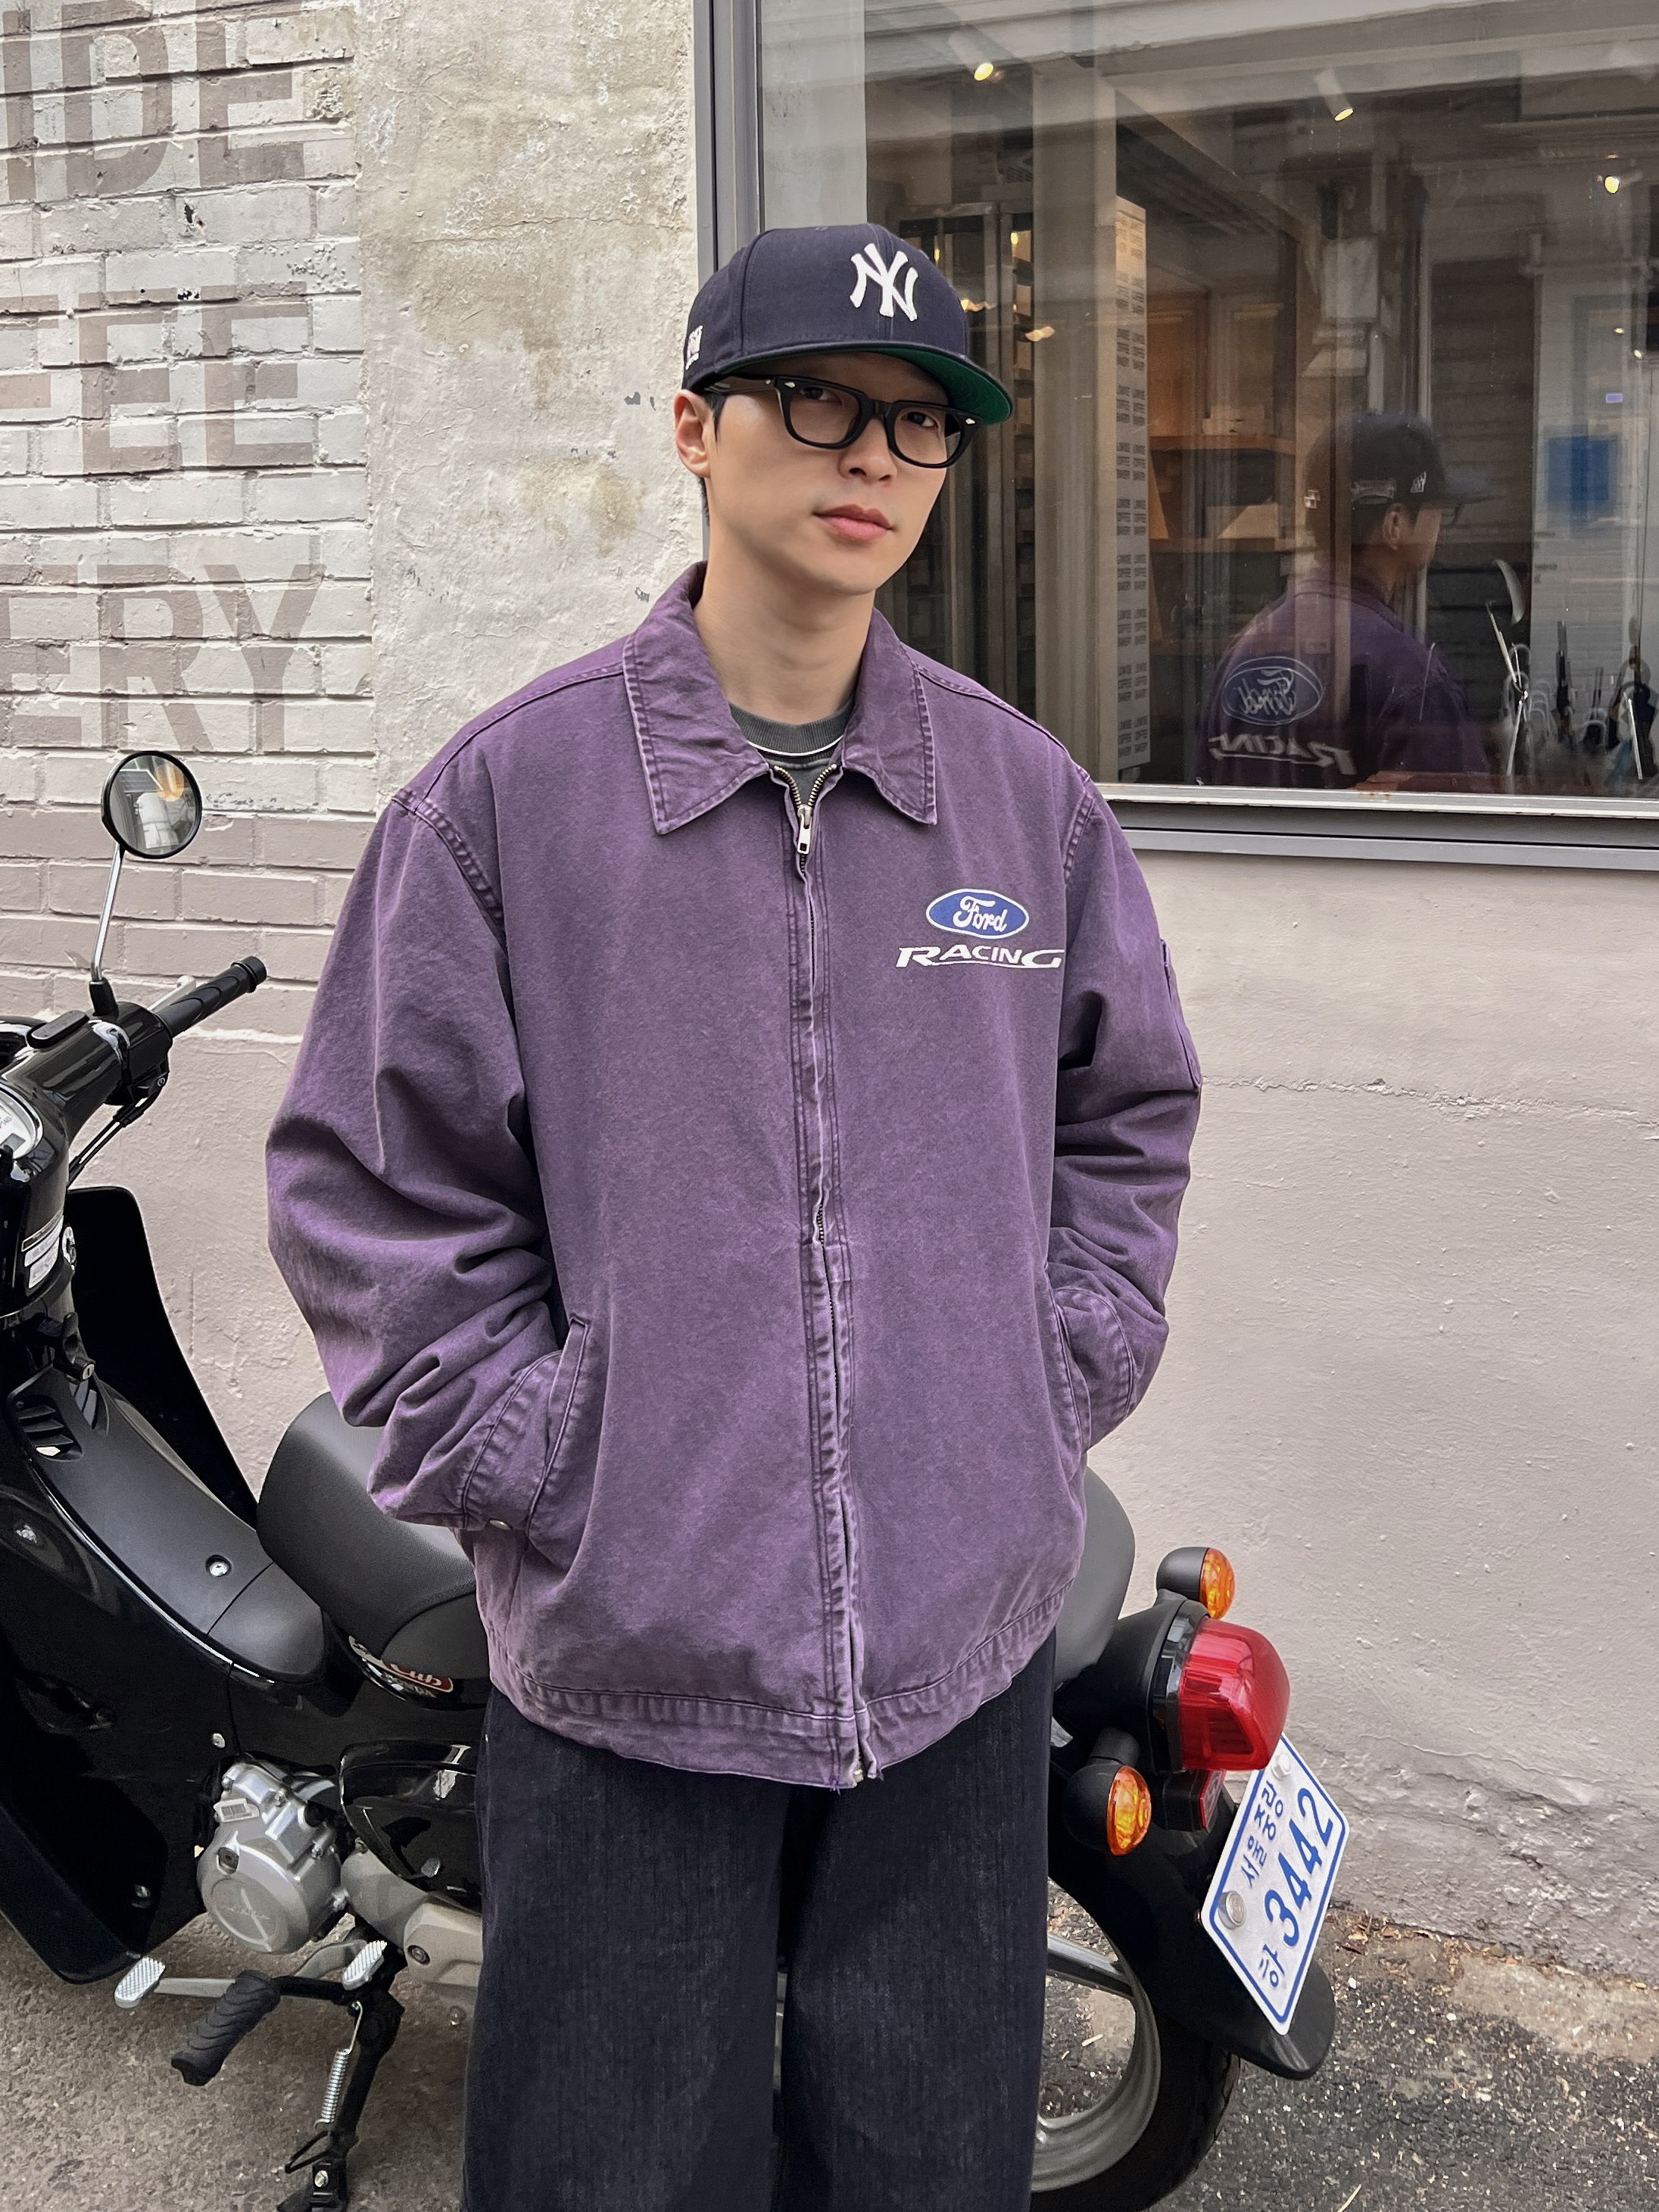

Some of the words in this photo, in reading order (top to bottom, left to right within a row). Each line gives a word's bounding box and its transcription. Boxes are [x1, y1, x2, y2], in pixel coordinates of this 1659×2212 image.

[850, 243, 918, 322] NY
[0, 564, 327, 751] ERY
[896, 944, 1065, 968] RACING
[953, 896, 1008, 933] Ford
[1240, 1836, 1266, 1887] 서울
[1254, 1780, 1284, 1842] 중랑
[1264, 1787, 1334, 1948] 3442
